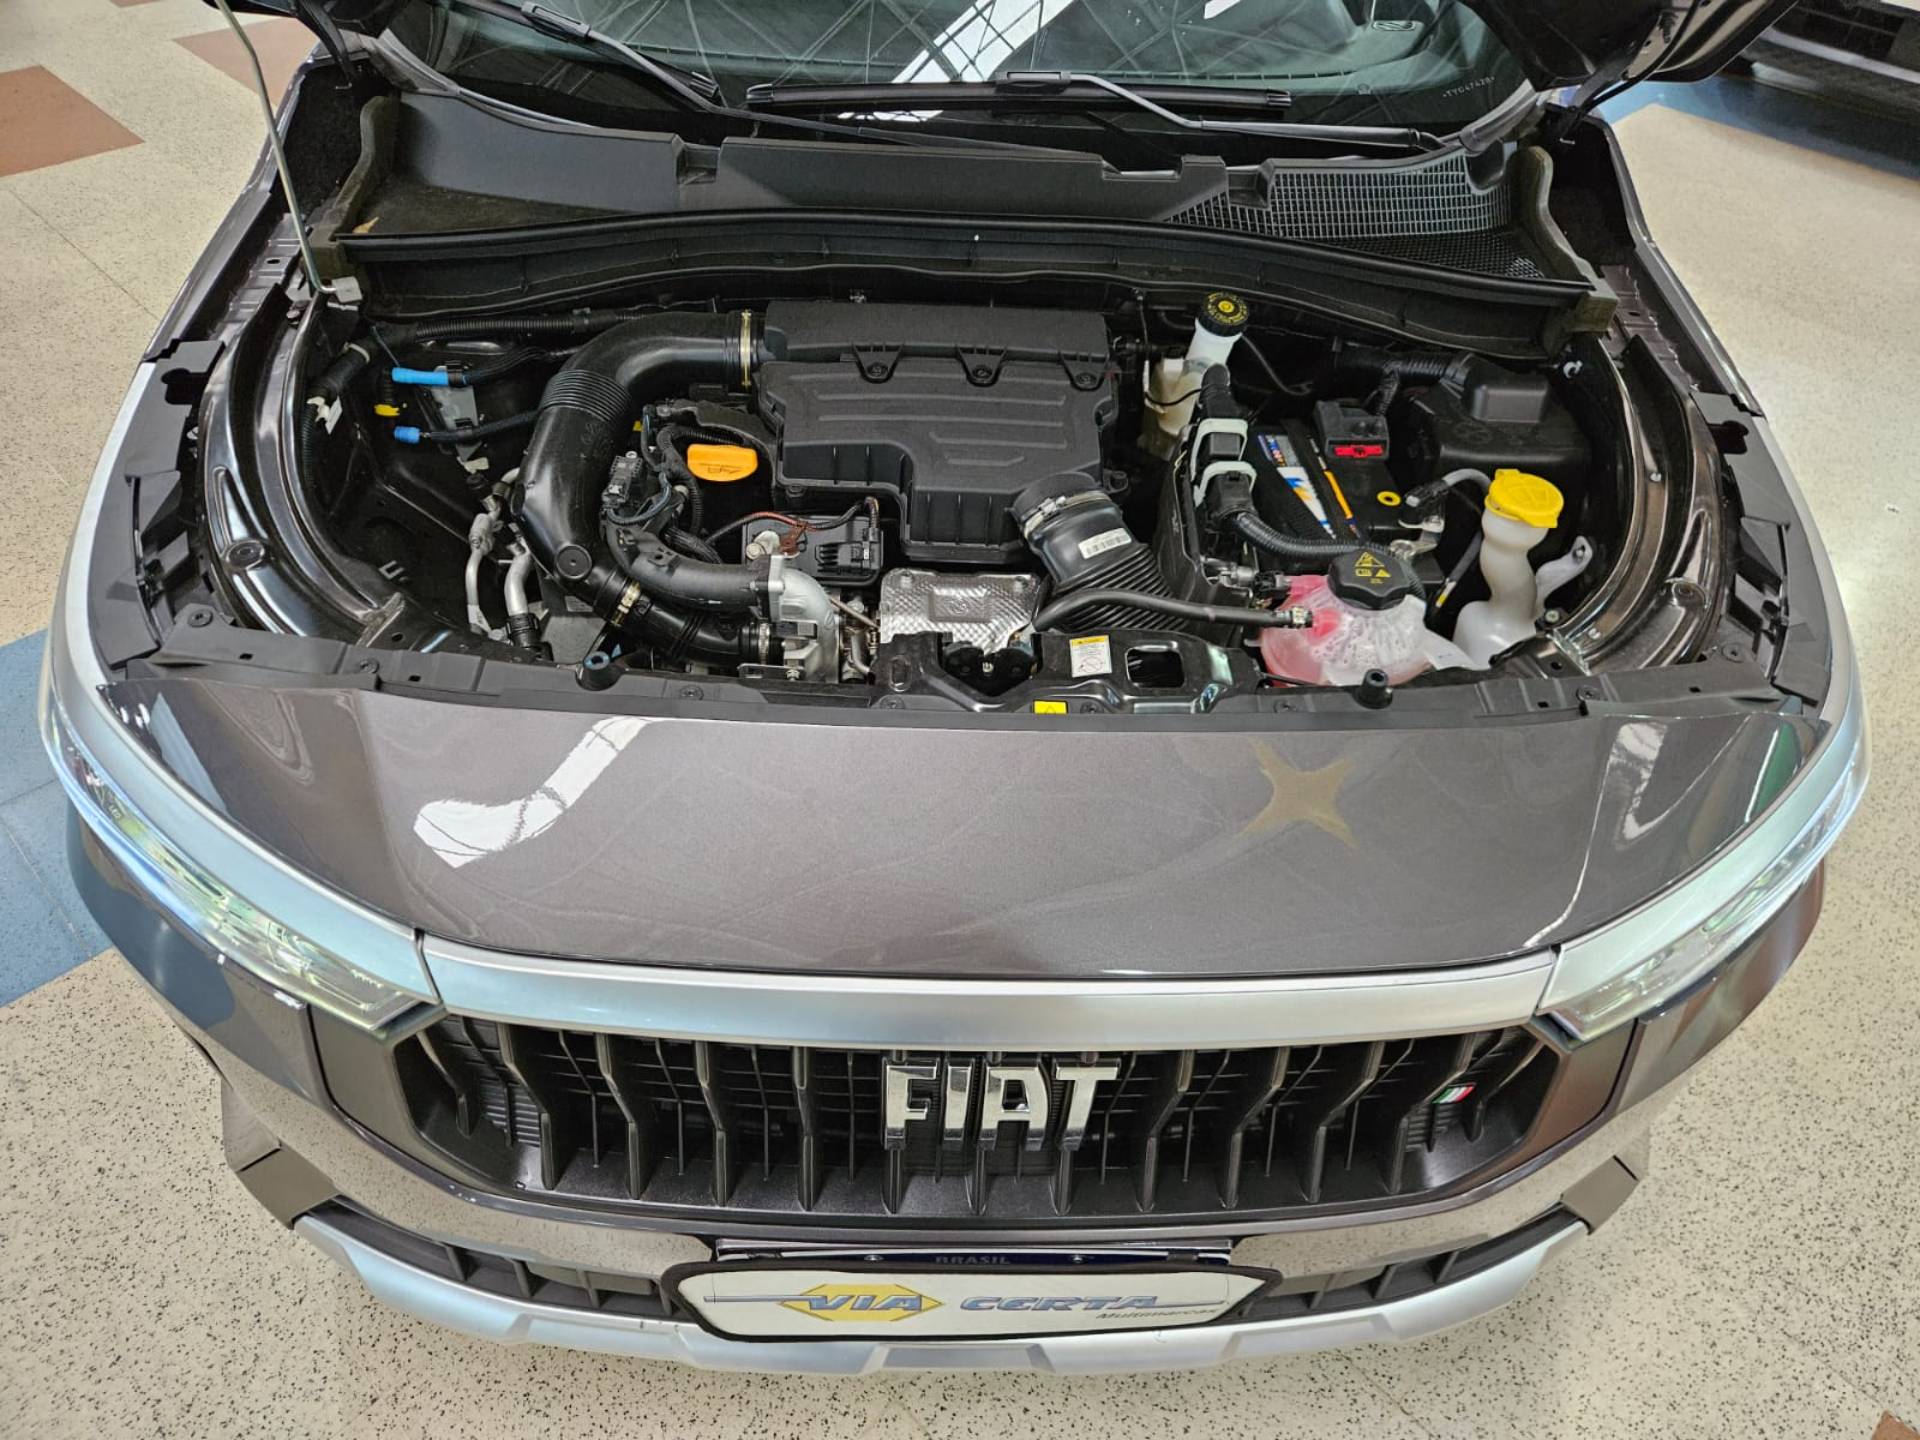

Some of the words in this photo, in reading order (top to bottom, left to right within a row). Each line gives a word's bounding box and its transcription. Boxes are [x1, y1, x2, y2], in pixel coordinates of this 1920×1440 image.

[883, 1061, 1120, 1146] FIAT
[935, 1255, 1010, 1265] BRASIL
[809, 1294, 923, 1311] VIA
[959, 1295, 1158, 1311] CERTA
